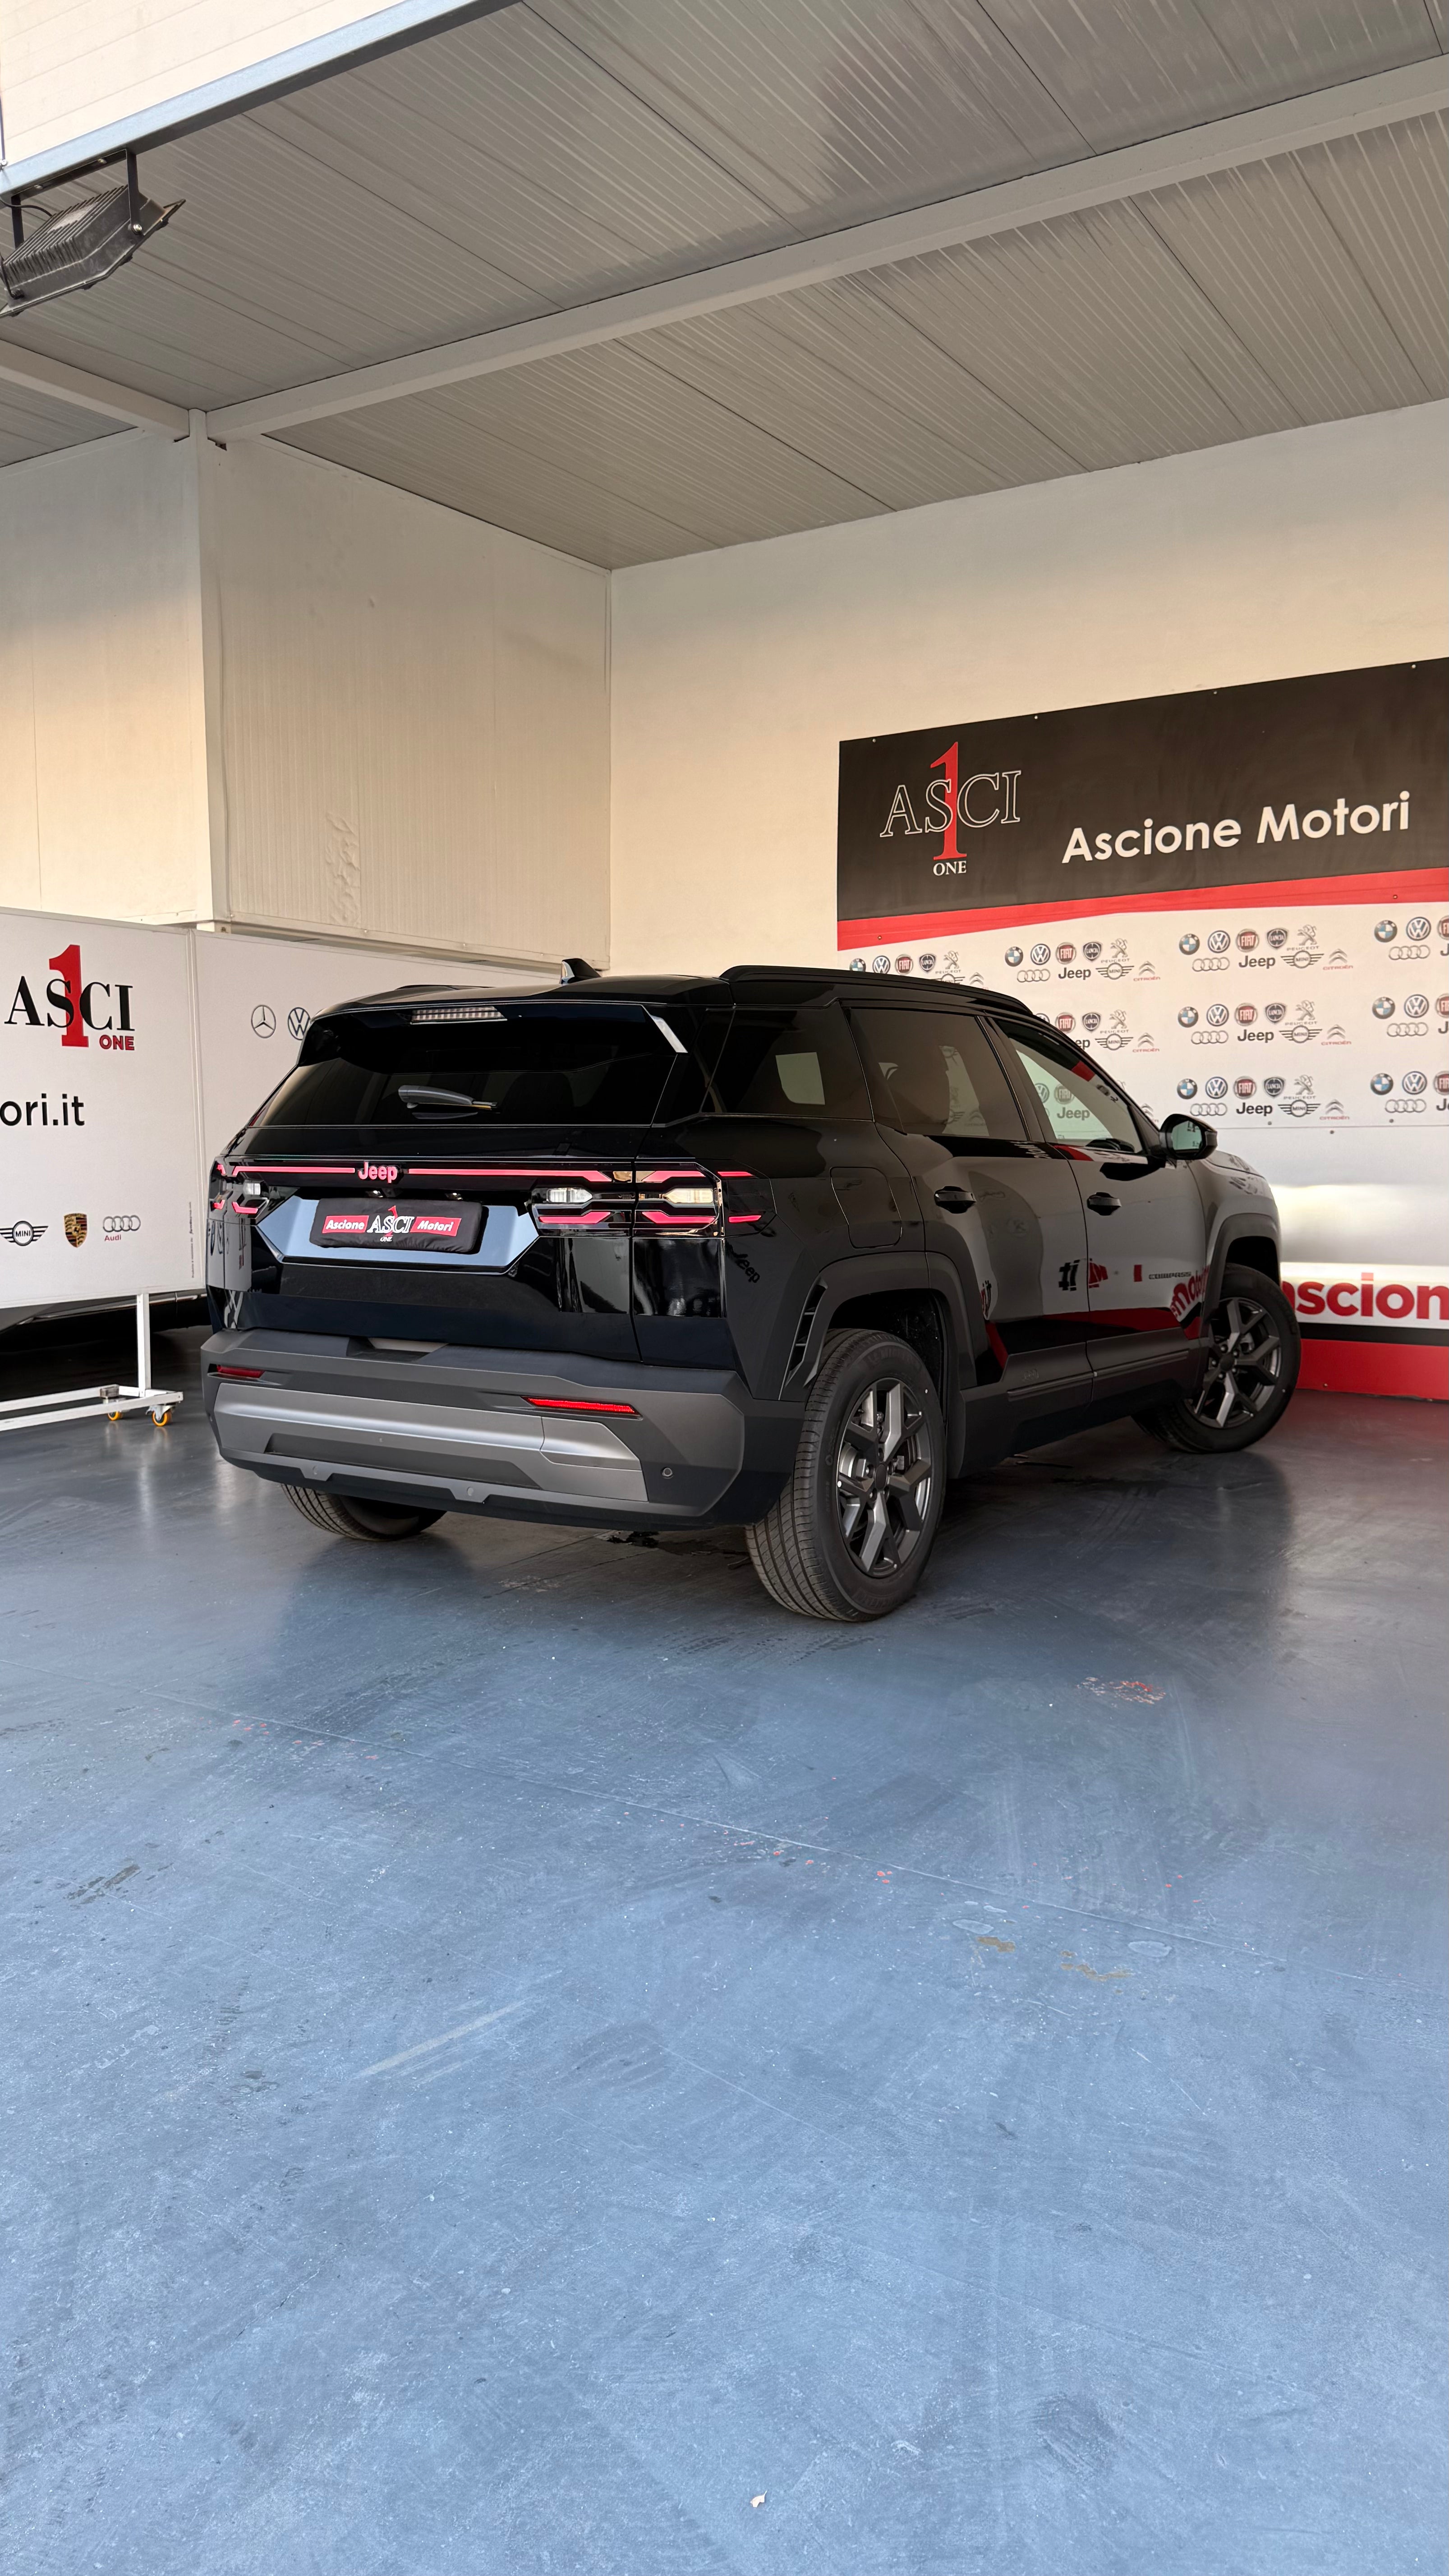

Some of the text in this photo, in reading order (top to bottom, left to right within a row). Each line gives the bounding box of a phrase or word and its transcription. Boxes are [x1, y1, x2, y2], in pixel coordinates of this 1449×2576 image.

[880, 770, 1022, 838] ASCI
[1062, 791, 1410, 864] Ascione Motori
[933, 860, 968, 876] ONE
[1240, 935, 1255, 947] FIAT
[1060, 948, 1072, 959] FIAT
[898, 959, 910, 971] FIAT
[1238, 955, 1276, 969] Jeep
[1058, 967, 1091, 980] Jeep
[4, 975, 135, 1031] ASCI
[1239, 1009, 1254, 1021] FIAT
[1059, 1018, 1072, 1029] FIAT
[99, 1034, 135, 1051] ONE
[1237, 1029, 1274, 1044] Jeep
[1075, 1039, 1091, 1050] ep
[1238, 1082, 1252, 1094] FIAT
[0, 1093, 85, 1126] ori.it
[1057, 1107, 1090, 1121] Jeep
[1236, 1102, 1273, 1117] Jeep
[358, 1162, 398, 1183] Jeep
[326, 1219, 365, 1230] Ascione
[416, 1220, 454, 1232] Motori
[1148, 1271, 1191, 1280] COMPASS
